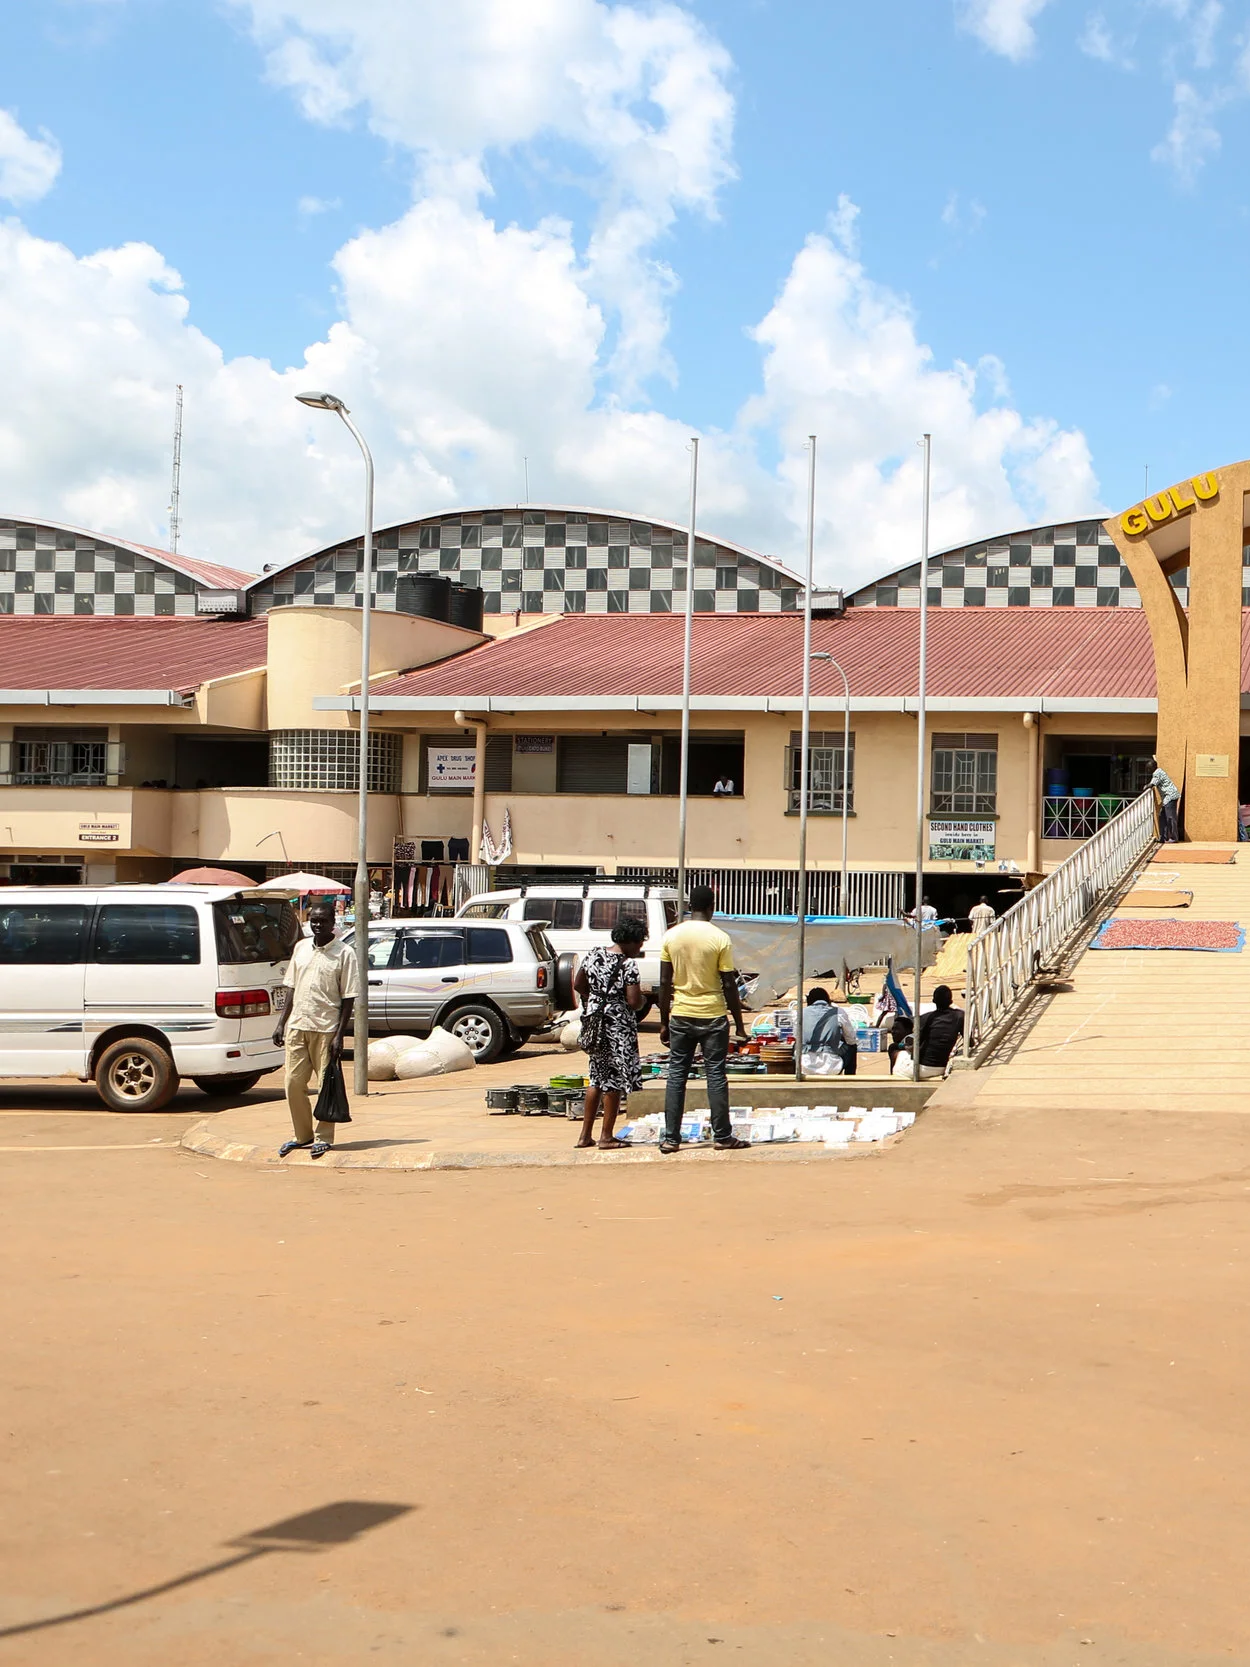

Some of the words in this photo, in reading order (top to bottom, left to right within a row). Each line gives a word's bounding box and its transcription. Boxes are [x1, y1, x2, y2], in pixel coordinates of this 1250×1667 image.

[1120, 471, 1219, 536] GULU
[930, 822, 952, 831] SECOND
[953, 822, 968, 831] HAND
[969, 823, 993, 831] CLOTHES
